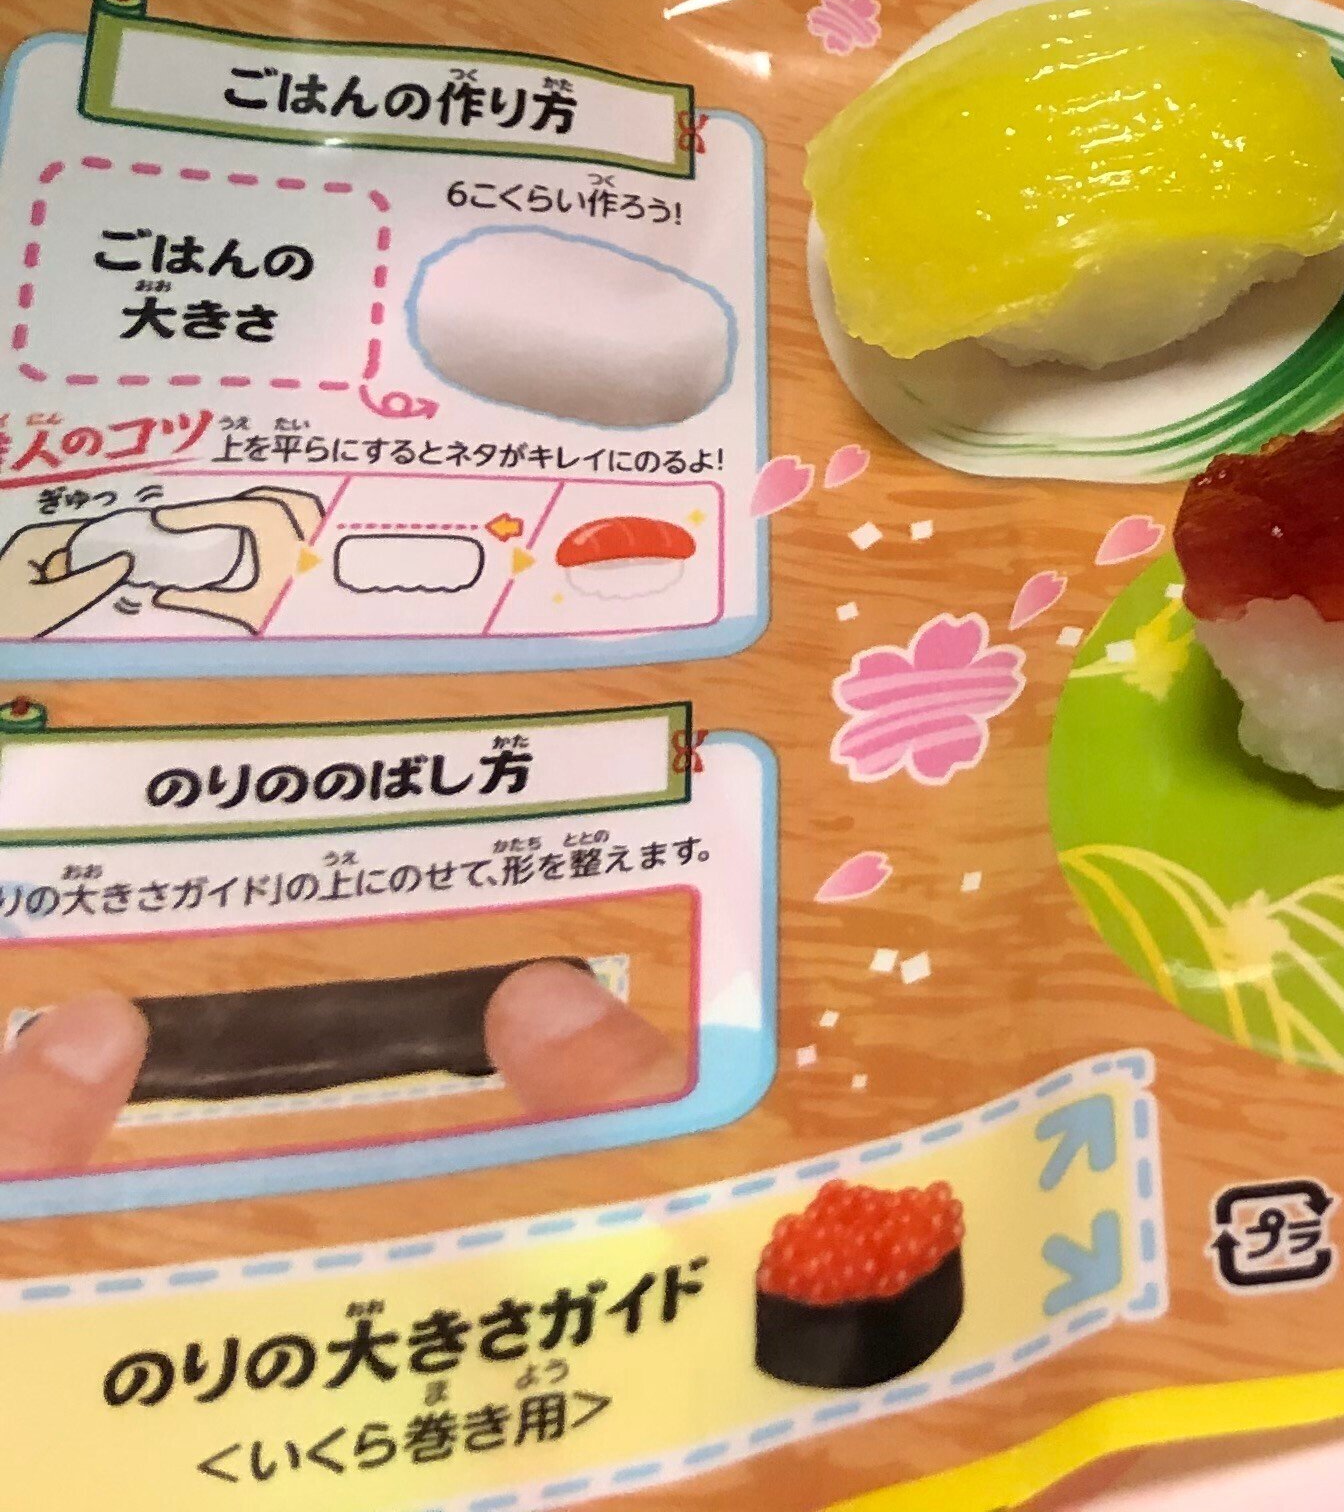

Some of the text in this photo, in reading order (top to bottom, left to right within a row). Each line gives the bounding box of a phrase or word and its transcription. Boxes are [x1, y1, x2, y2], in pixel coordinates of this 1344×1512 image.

[223, 66, 578, 134] ごはんの作り方
[447, 180, 683, 226] 6こくらい作ろう!
[94, 228, 314, 281] ごはんの
[121, 296, 279, 341] 大きさ
[0, 409, 214, 471] 人のコツ
[211, 430, 725, 475] 上を平らにするとネタがキレイにのるよ!
[37, 486, 118, 516] ぎゅっ
[146, 748, 533, 809] のりののばし方
[1246, 1207, 1322, 1260] プラ
[103, 1255, 709, 1408] のりの大きさガイド
